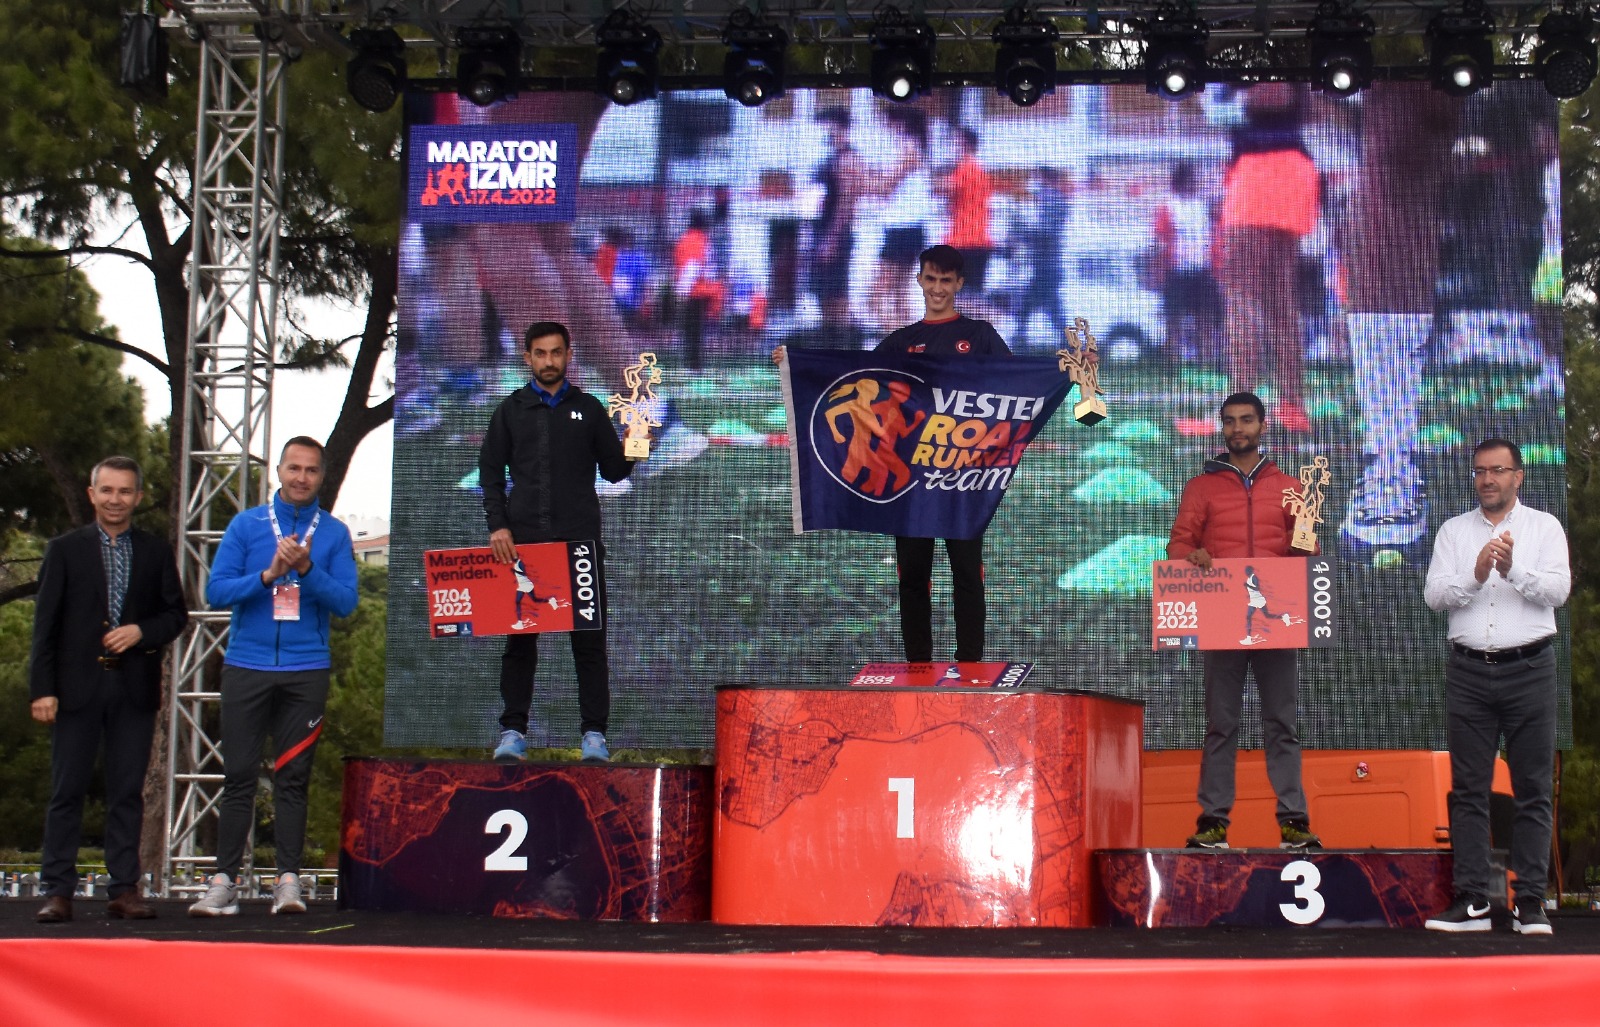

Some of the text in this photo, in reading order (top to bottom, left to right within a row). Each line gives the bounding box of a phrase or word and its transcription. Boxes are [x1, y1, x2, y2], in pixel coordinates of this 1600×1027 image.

[428, 140, 557, 162] MARATON
[924, 467, 1012, 492] team
[431, 567, 498, 585] yeniden.
[1158, 578, 1230, 597] yeniden.
[433, 602, 473, 617] 2022
[1157, 614, 1198, 629] 2022
[888, 777, 915, 838] 1
[484, 809, 529, 871] 2
[1279, 860, 1326, 925] 3
